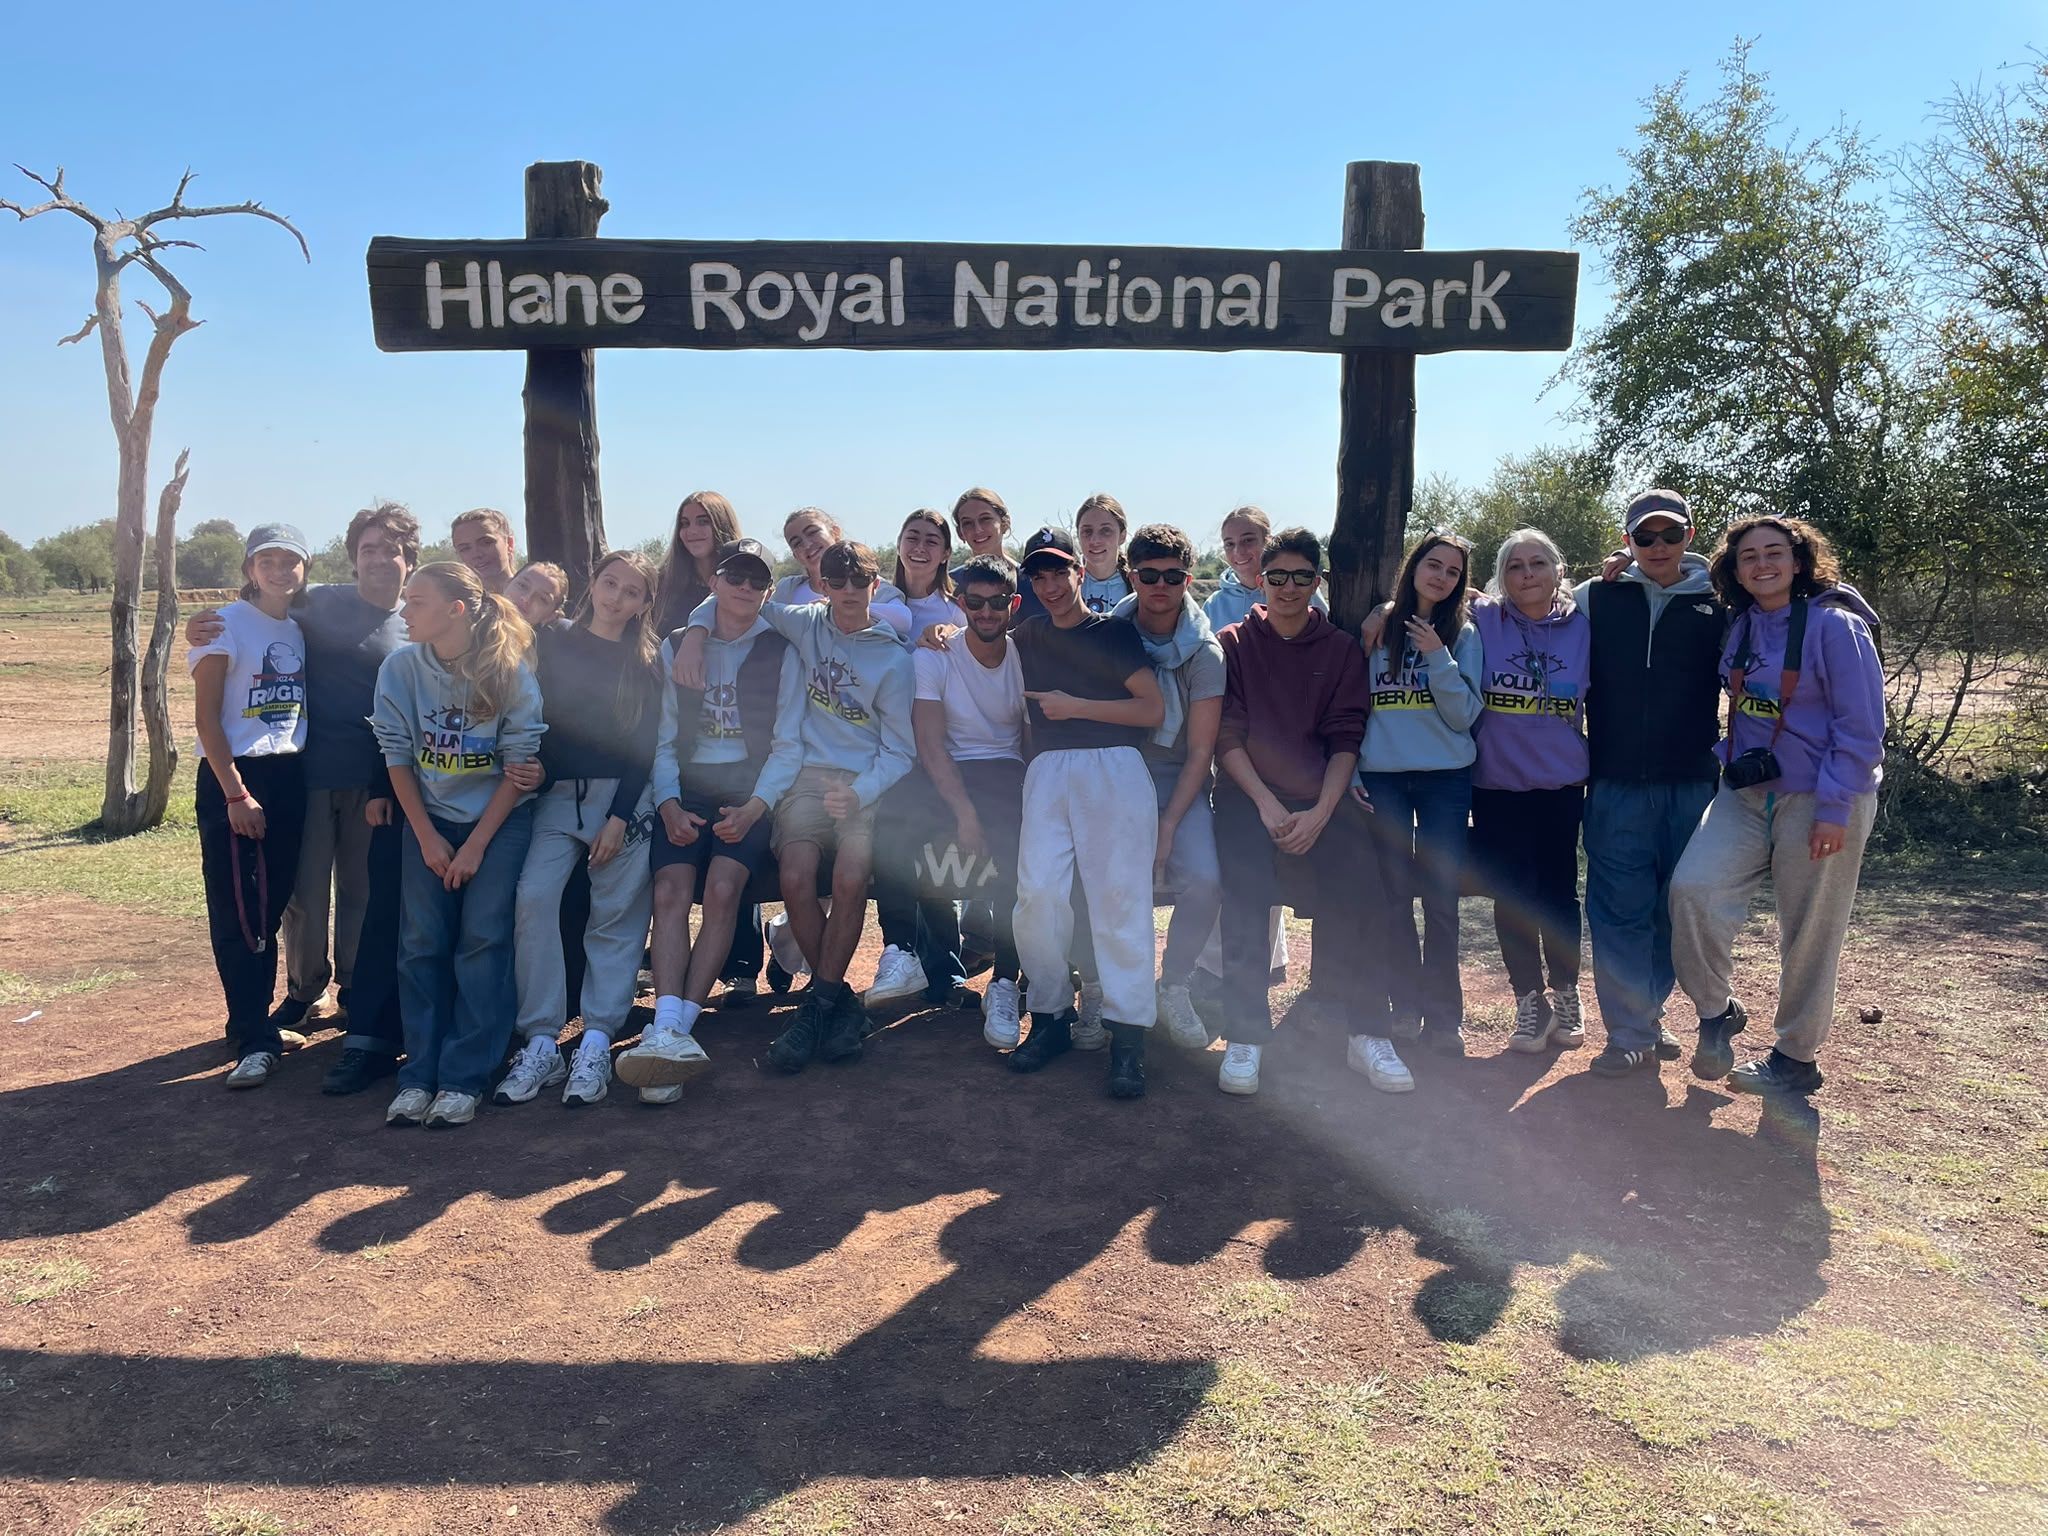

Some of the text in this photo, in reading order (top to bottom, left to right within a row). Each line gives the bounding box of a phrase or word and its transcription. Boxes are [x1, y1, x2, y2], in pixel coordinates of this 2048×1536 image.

[426, 257, 1512, 344] Hlane Royal National Park
[251, 685, 304, 706] RUGB
